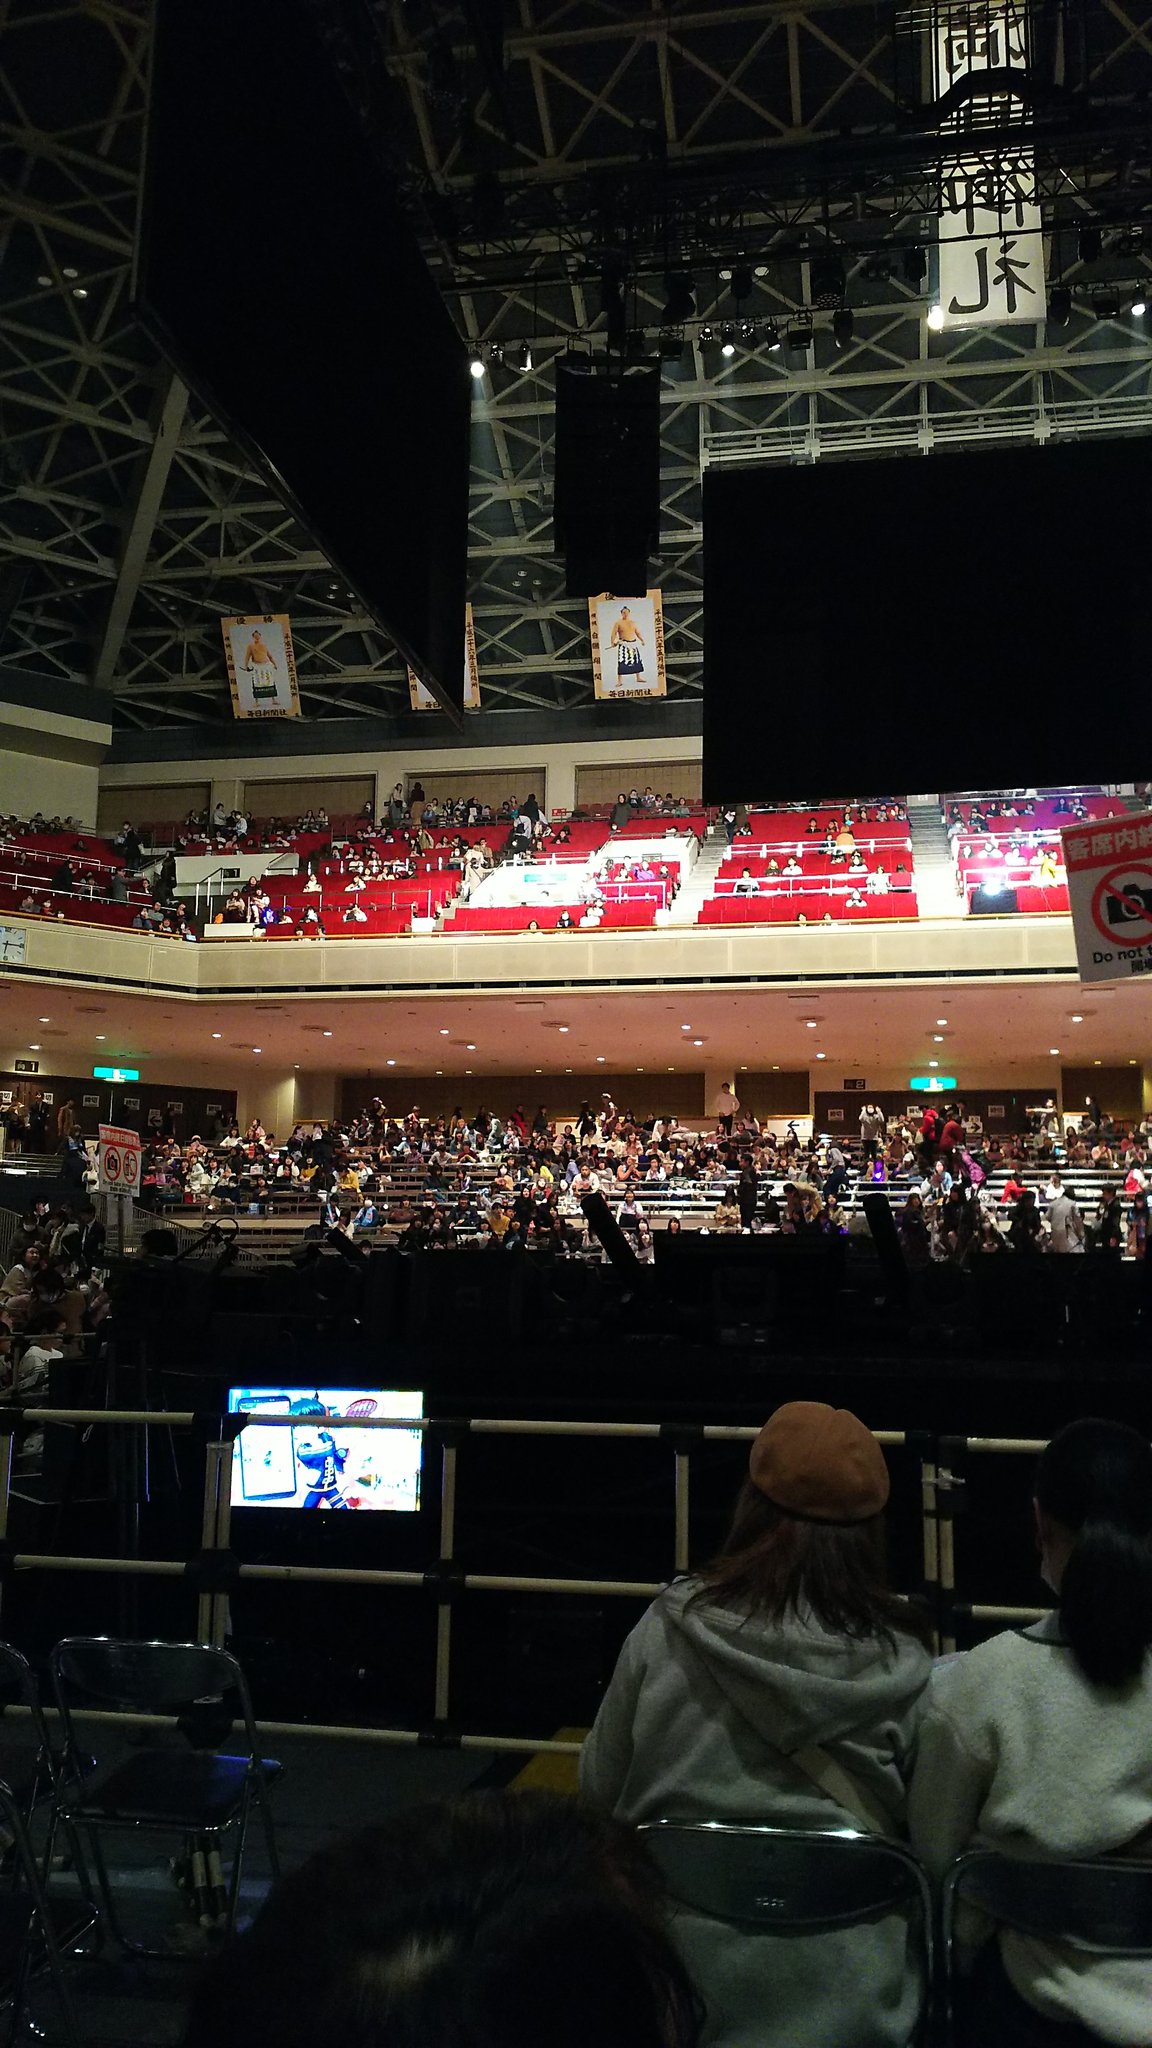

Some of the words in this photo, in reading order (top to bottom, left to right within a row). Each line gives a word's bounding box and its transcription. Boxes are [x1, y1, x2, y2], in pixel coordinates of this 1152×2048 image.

[608, 688, 653, 698] 毎日新聞社
[1093, 951, 1113, 964] Do
[1118, 947, 1143, 960] not
